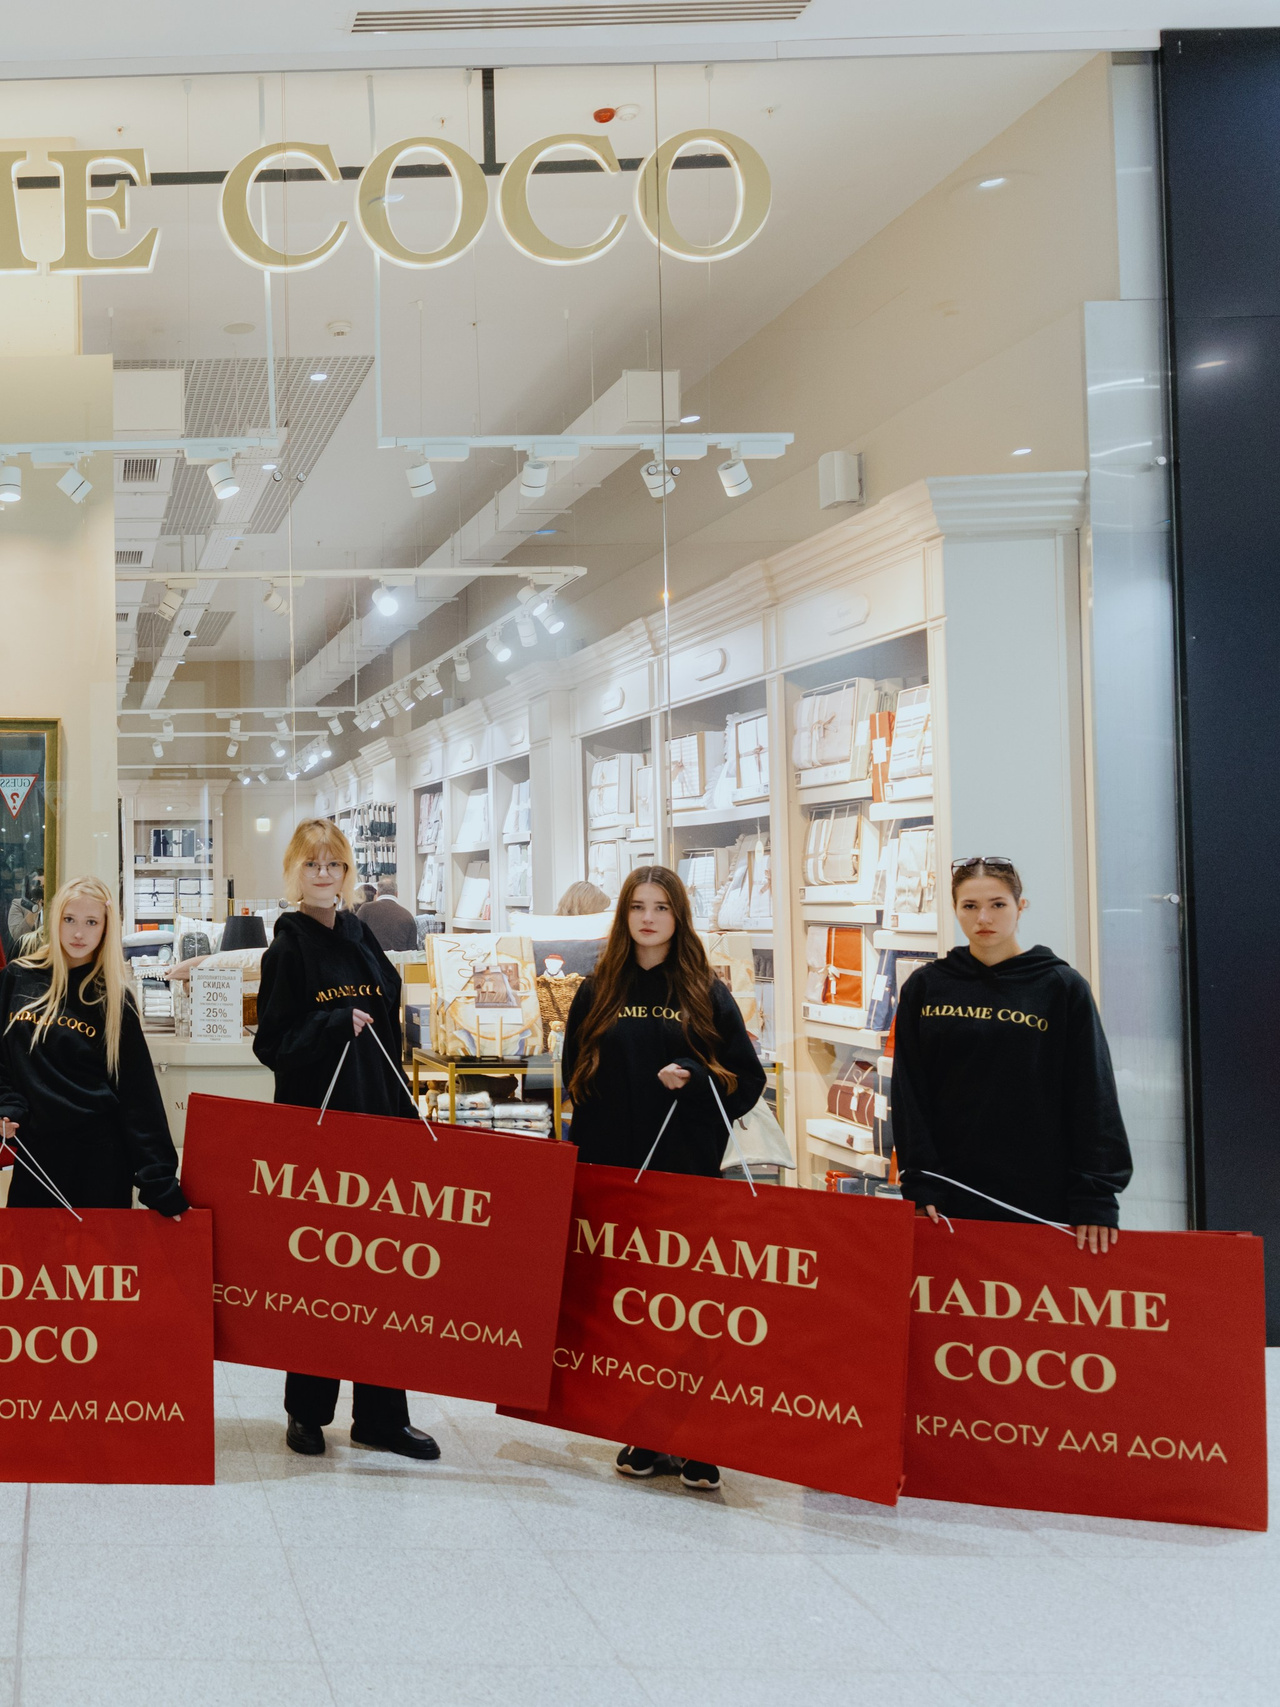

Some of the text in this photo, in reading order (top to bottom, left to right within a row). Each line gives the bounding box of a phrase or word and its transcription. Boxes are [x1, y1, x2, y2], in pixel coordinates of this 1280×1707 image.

[218, 129, 772, 273] COCO
[203, 981, 231, 989] СКИДКА
[203, 991, 227, 1002] -20%
[57, 1016, 96, 1038] COCO
[202, 1008, 227, 1018] -25%
[202, 1024, 227, 1034] -30%
[920, 1005, 1049, 1032] MADAME COCO
[249, 1158, 491, 1228] MADAME
[288, 1226, 441, 1280] COCO
[572, 1218, 819, 1290] MADAME
[213, 1283, 523, 1349] ЕСУ КРАСОТУ ДЛЯ ДОМА
[612, 1287, 768, 1347] COCO
[910, 1275, 1170, 1332] MADAME
[591, 1354, 704, 1395] КРАСОТУ
[710, 1379, 764, 1408] ДЛЯ
[771, 1391, 863, 1428] ДОМА
[934, 1342, 1117, 1394] COCO
[49, 1400, 98, 1423] ДЛЯ
[105, 1400, 185, 1423] ДОМА
[916, 1414, 1228, 1464] КРАСОТУ ДЛЯ ДОМА
